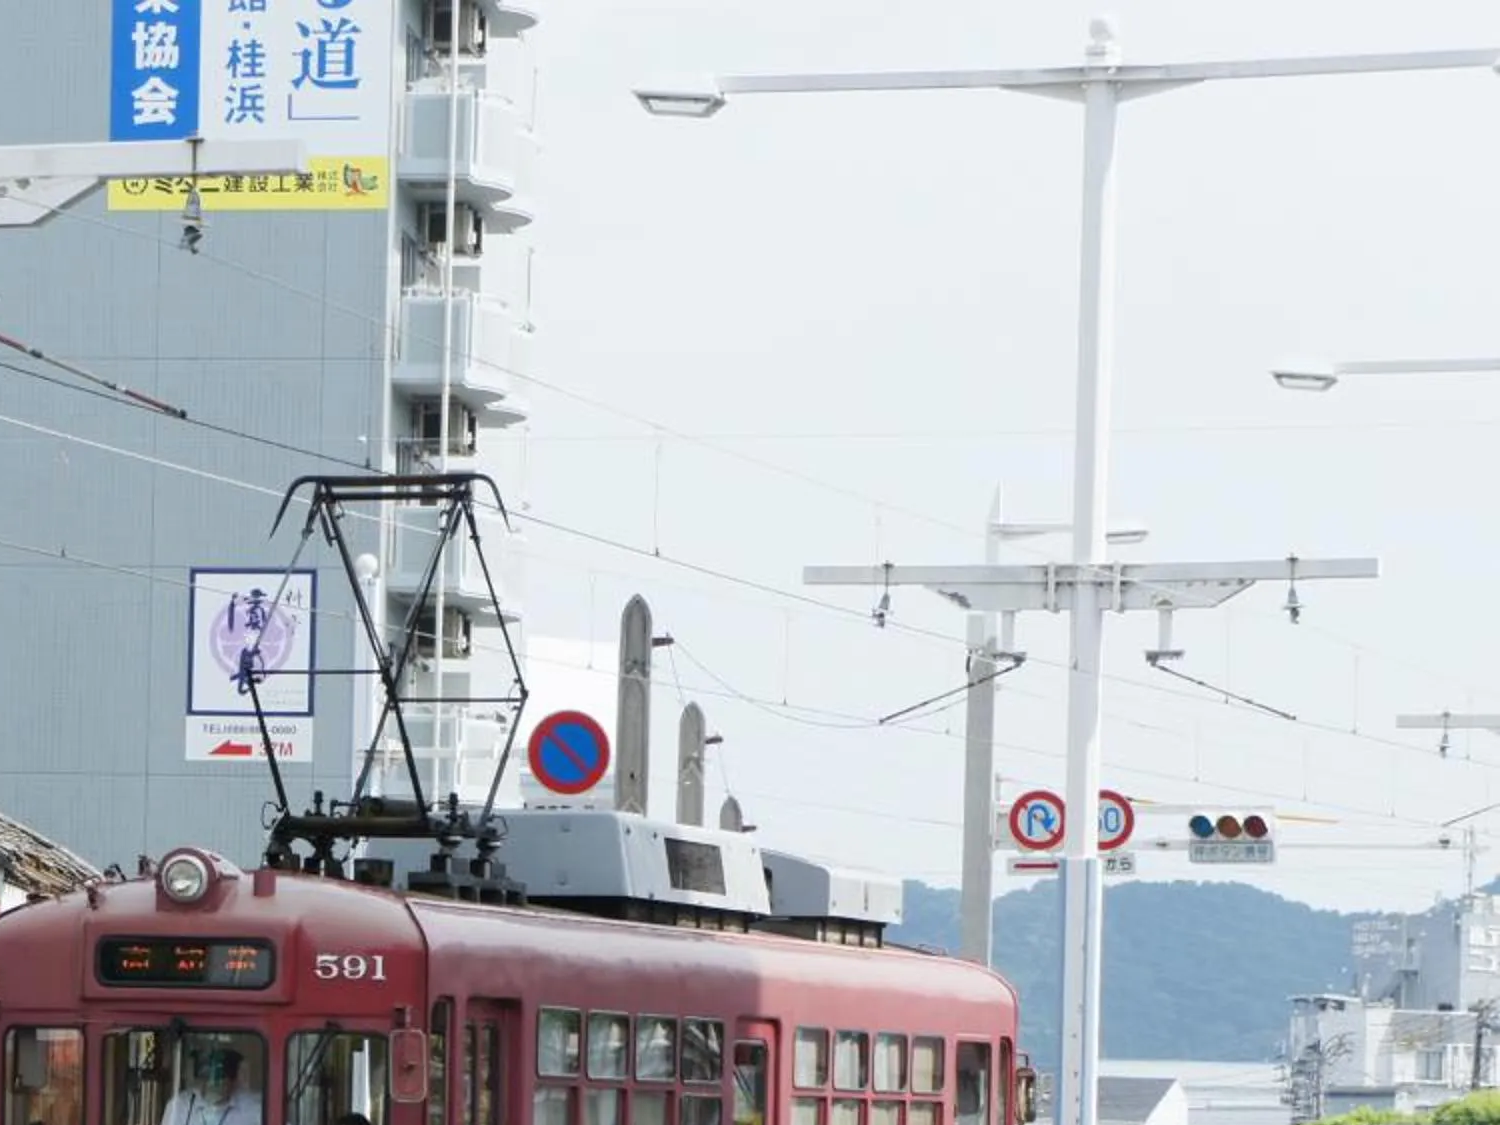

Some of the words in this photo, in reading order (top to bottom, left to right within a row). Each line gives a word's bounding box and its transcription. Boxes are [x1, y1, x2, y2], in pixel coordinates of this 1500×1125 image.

[132, 0, 179, 125] 協会
[288, 0, 362, 120] 道」
[316, 954, 386, 980] 591
